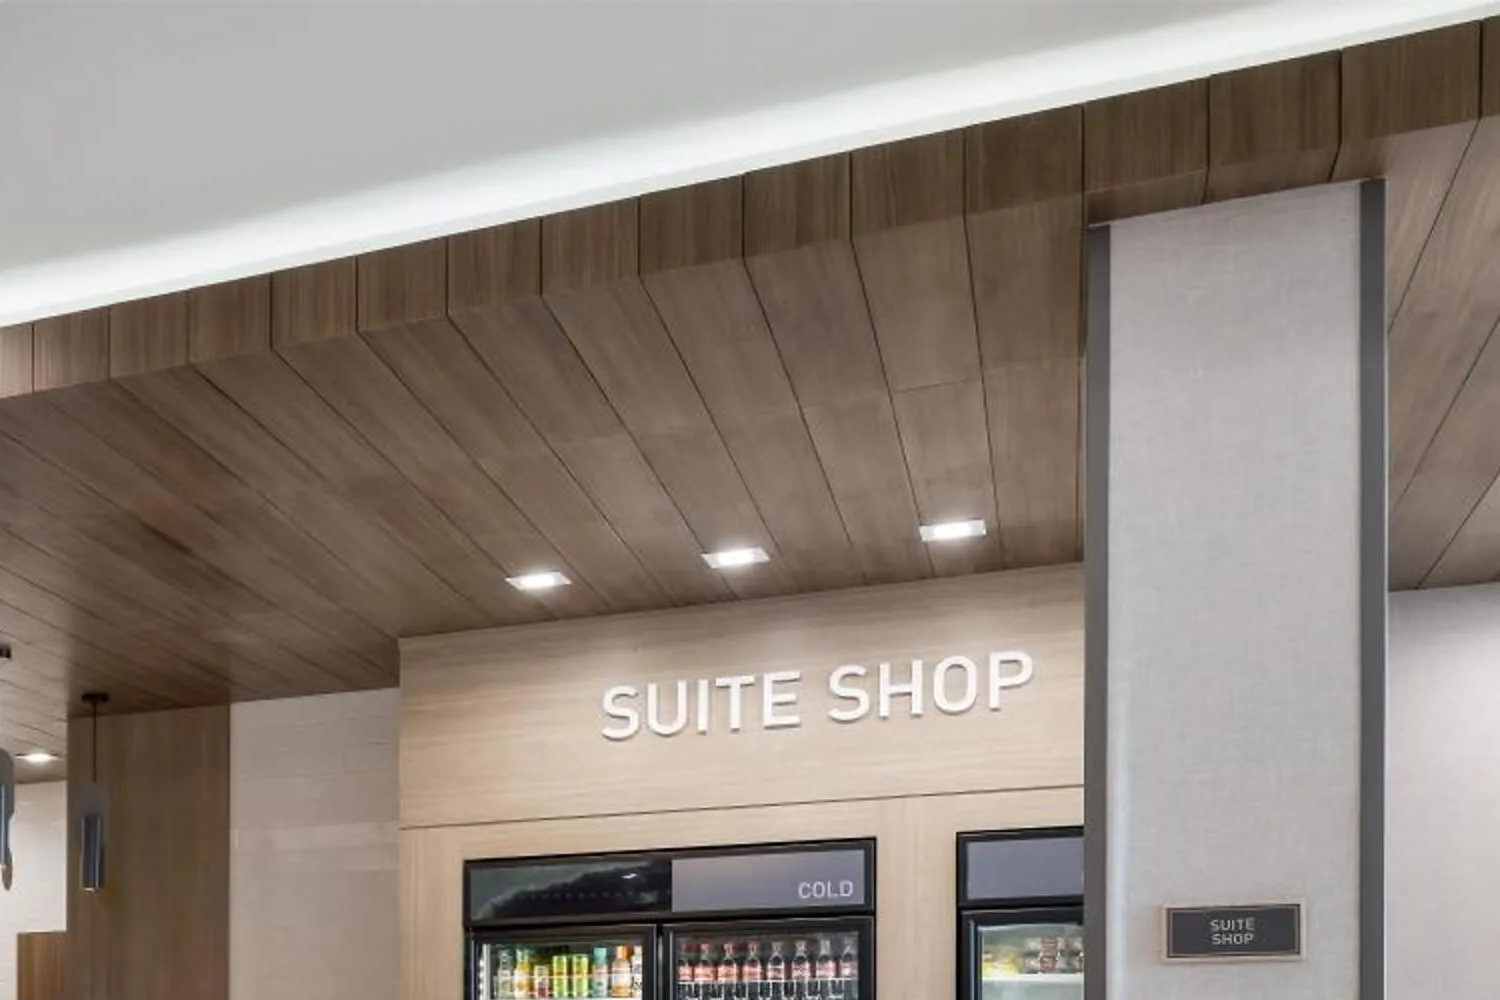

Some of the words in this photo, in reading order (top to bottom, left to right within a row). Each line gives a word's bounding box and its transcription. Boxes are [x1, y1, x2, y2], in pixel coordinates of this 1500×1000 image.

[601, 669, 802, 741] SUITE
[828, 649, 1033, 723] SHOP
[798, 881, 854, 898] COLD
[1209, 917, 1255, 931] SUITE
[1211, 933, 1254, 945] SHOP
